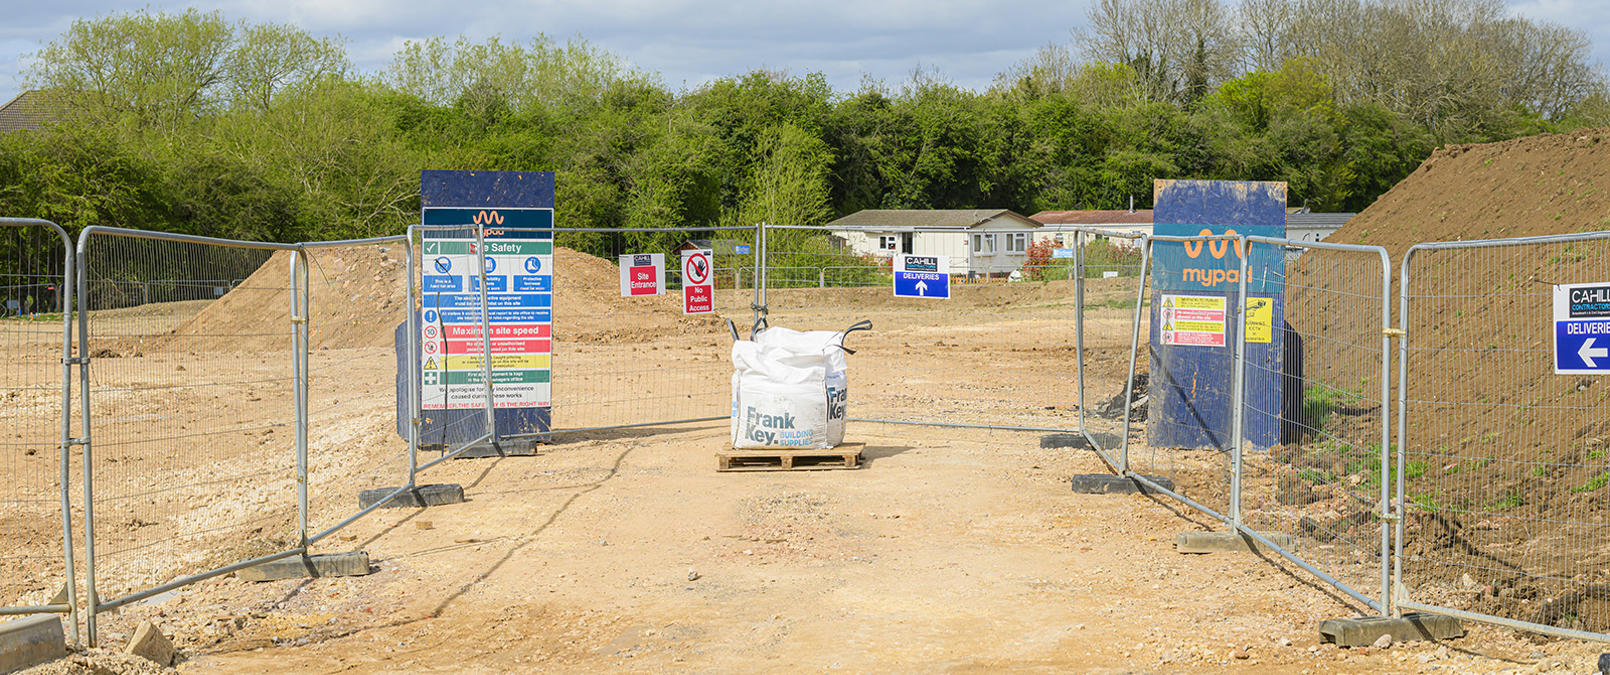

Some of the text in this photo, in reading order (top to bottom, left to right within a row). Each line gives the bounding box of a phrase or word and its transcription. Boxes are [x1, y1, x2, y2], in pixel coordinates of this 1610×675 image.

[491, 243, 522, 253] Safety
[906, 257, 936, 265] CAHILL
[637, 272, 649, 280] Site
[631, 281, 656, 289] Entrance
[495, 326, 514, 334] site
[515, 326, 539, 336] speed
[1567, 323, 1610, 335] DELIVERIE
[747, 406, 796, 429] Frank
[780, 429, 814, 439] BUILDING
[780, 438, 814, 447] SUPPLIES
